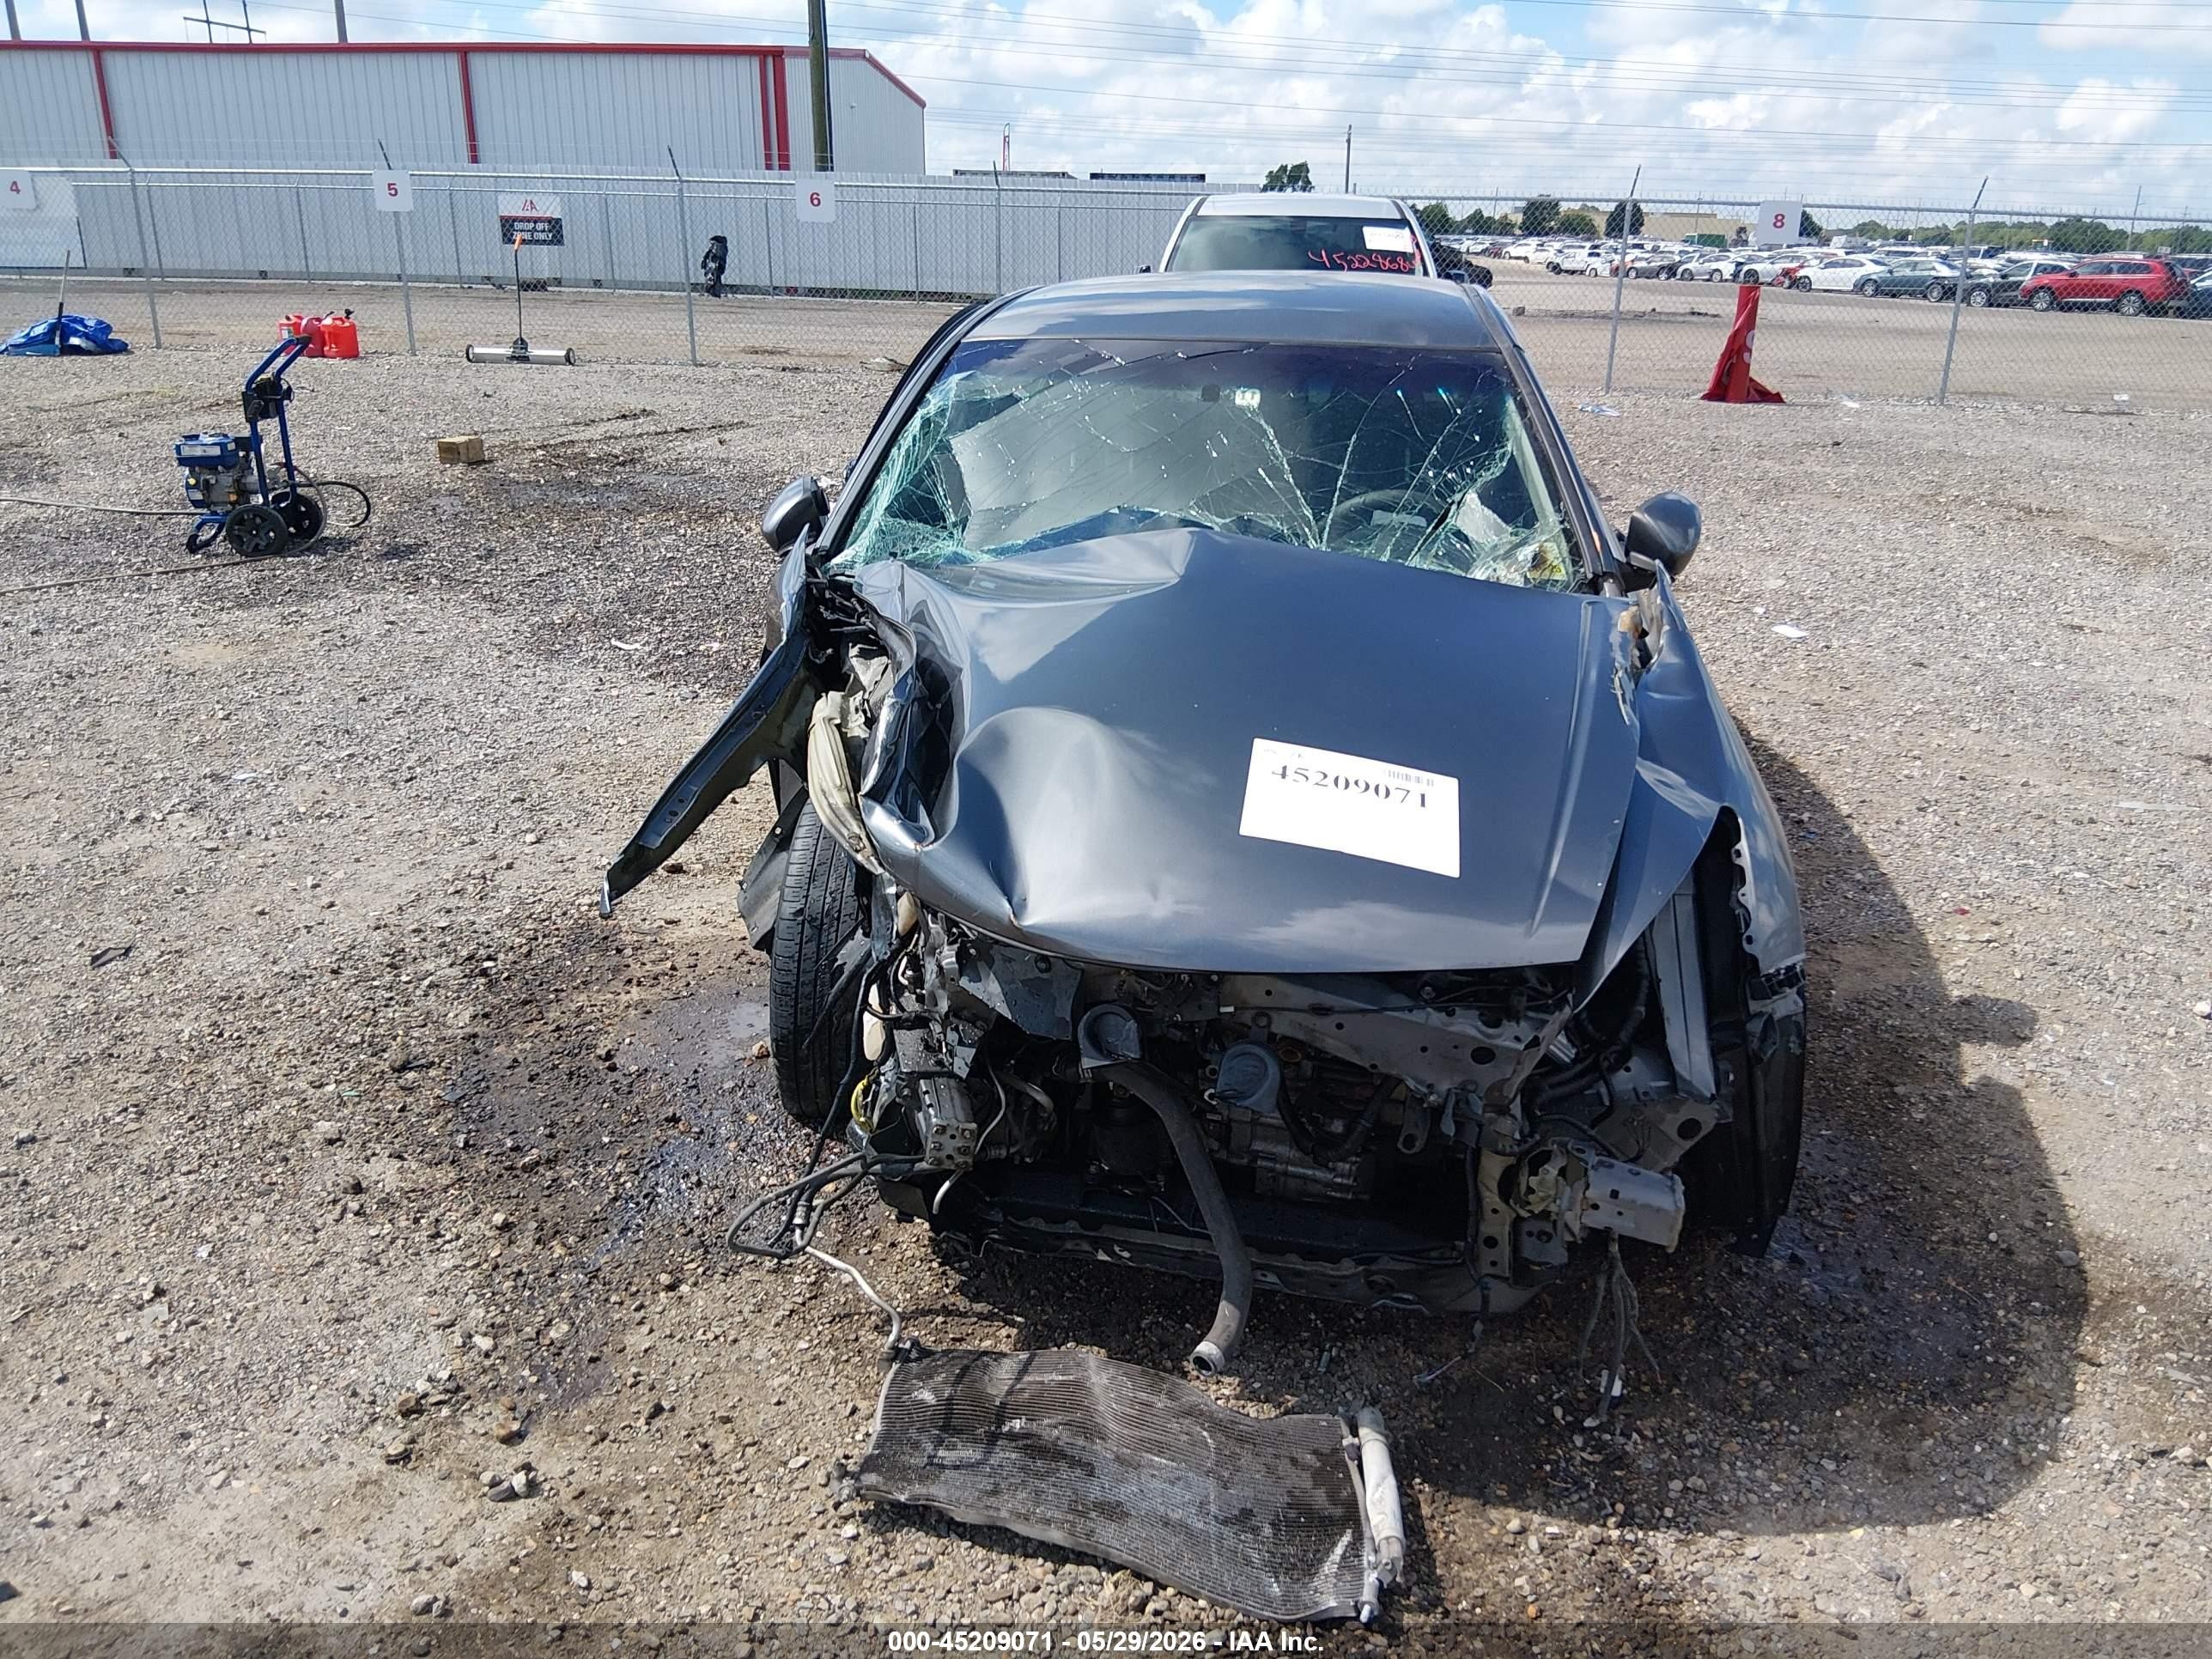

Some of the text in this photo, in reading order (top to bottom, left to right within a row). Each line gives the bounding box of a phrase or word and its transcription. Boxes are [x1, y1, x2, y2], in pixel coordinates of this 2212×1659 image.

[10, 180, 21, 195] 4
[387, 183, 398, 198] 5
[810, 191, 822, 208] 6
[514, 222, 550, 232] DROP OFF
[1772, 213, 1785, 229] 8
[512, 231, 553, 240] ZNE ONLY
[1272, 765, 1426, 808] 45209071
